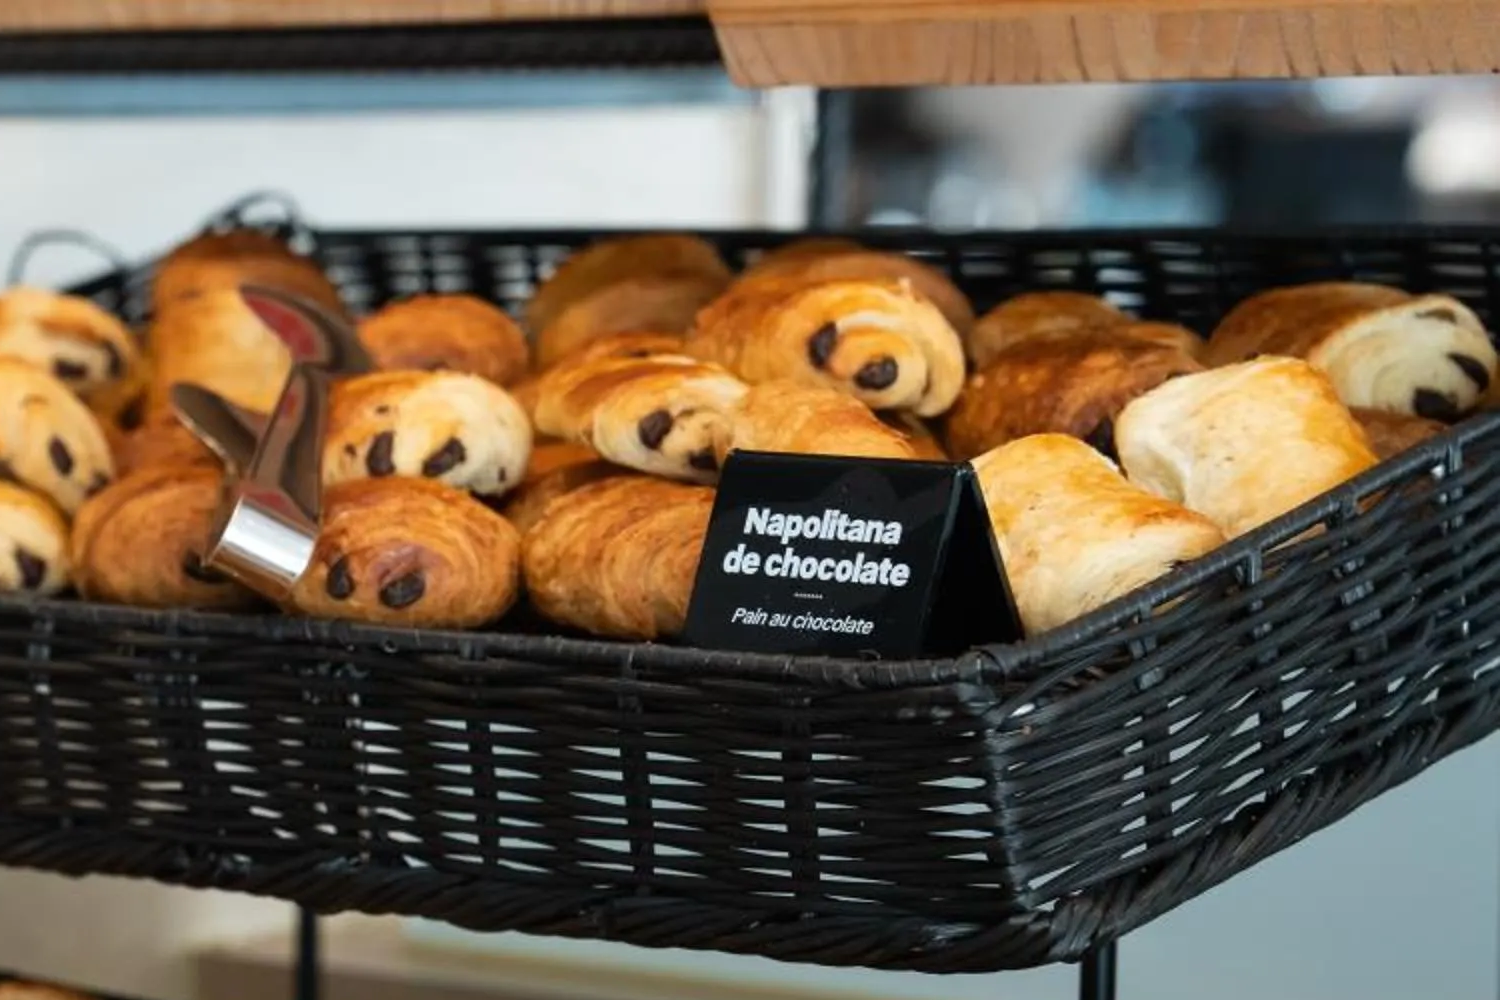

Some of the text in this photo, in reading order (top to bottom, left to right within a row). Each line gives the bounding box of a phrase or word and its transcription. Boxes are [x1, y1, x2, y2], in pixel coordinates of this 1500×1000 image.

[743, 507, 903, 545] Napolitana
[723, 543, 911, 587] de chocolate
[731, 607, 875, 635] Pain au chocolate
